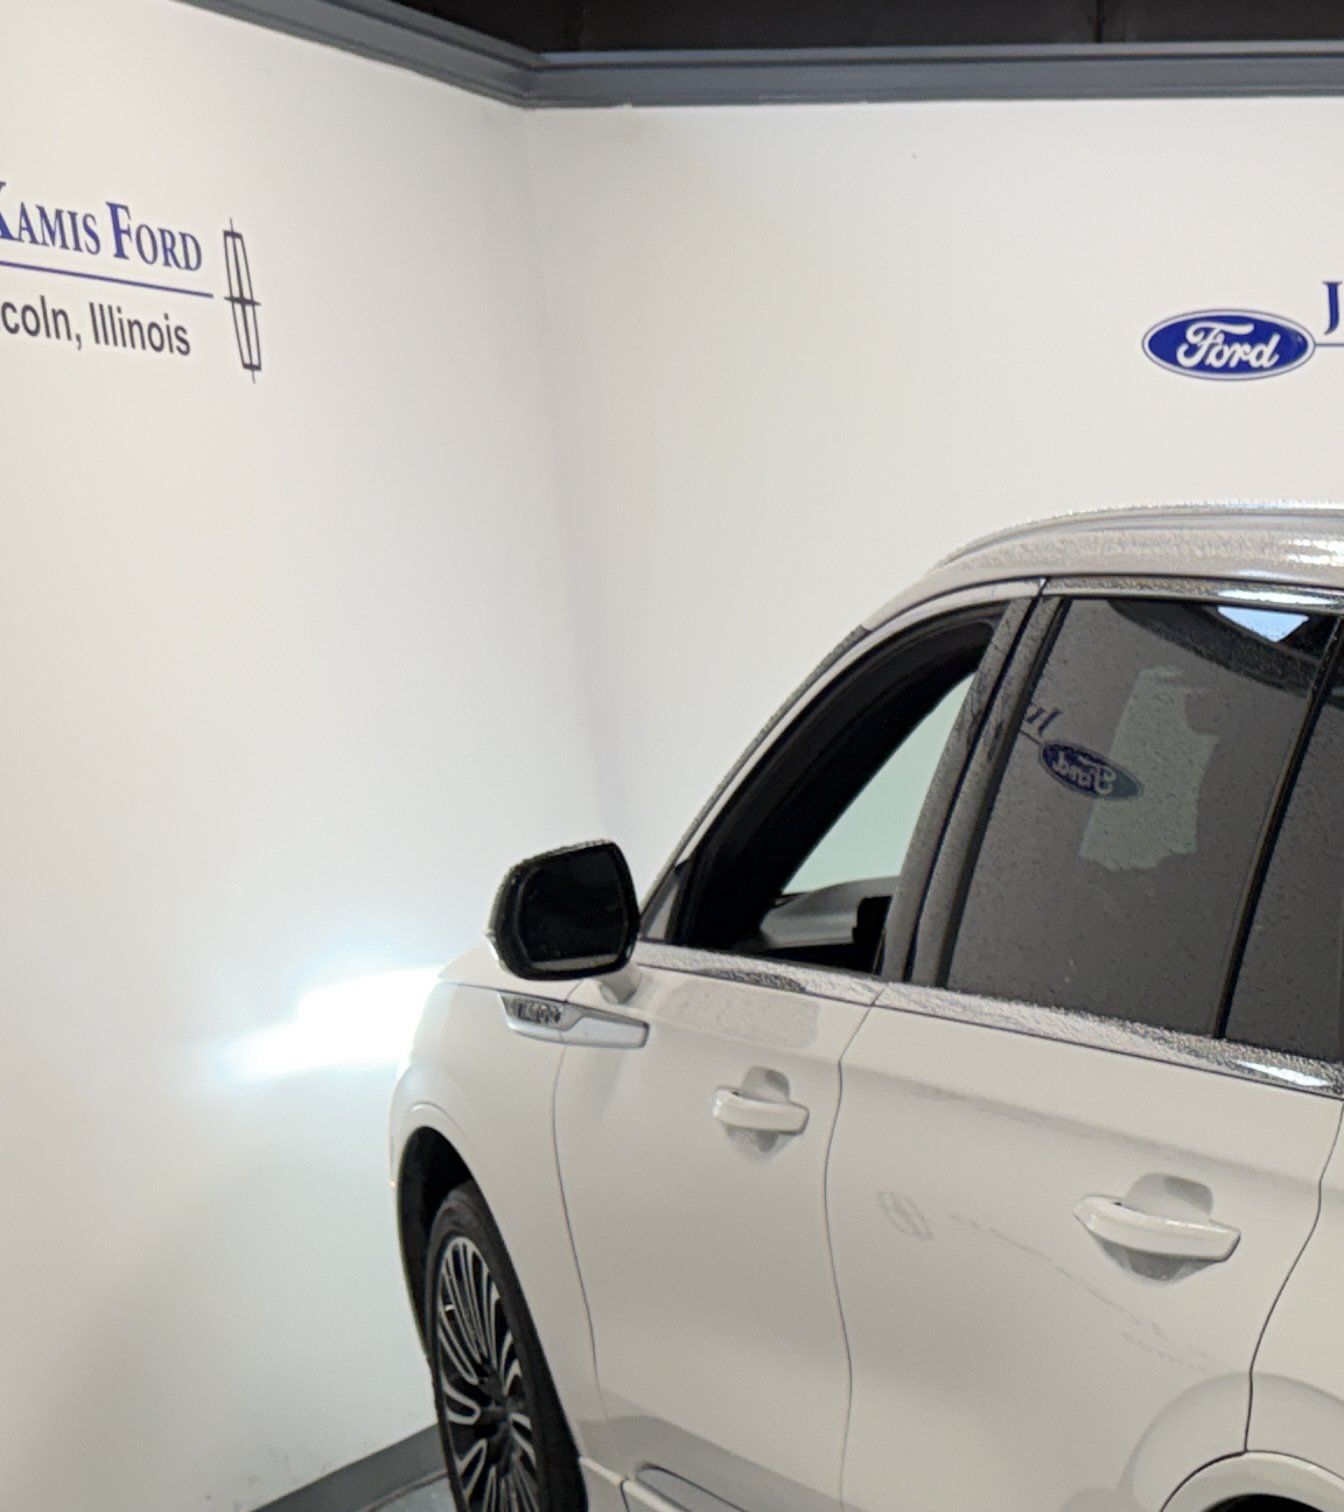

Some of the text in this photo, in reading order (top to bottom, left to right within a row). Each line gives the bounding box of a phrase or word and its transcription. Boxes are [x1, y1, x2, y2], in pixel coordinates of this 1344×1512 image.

[106, 201, 203, 272] FORD
[0, 294, 191, 357] coln, Illinois
[1176, 321, 1281, 371] Ford
